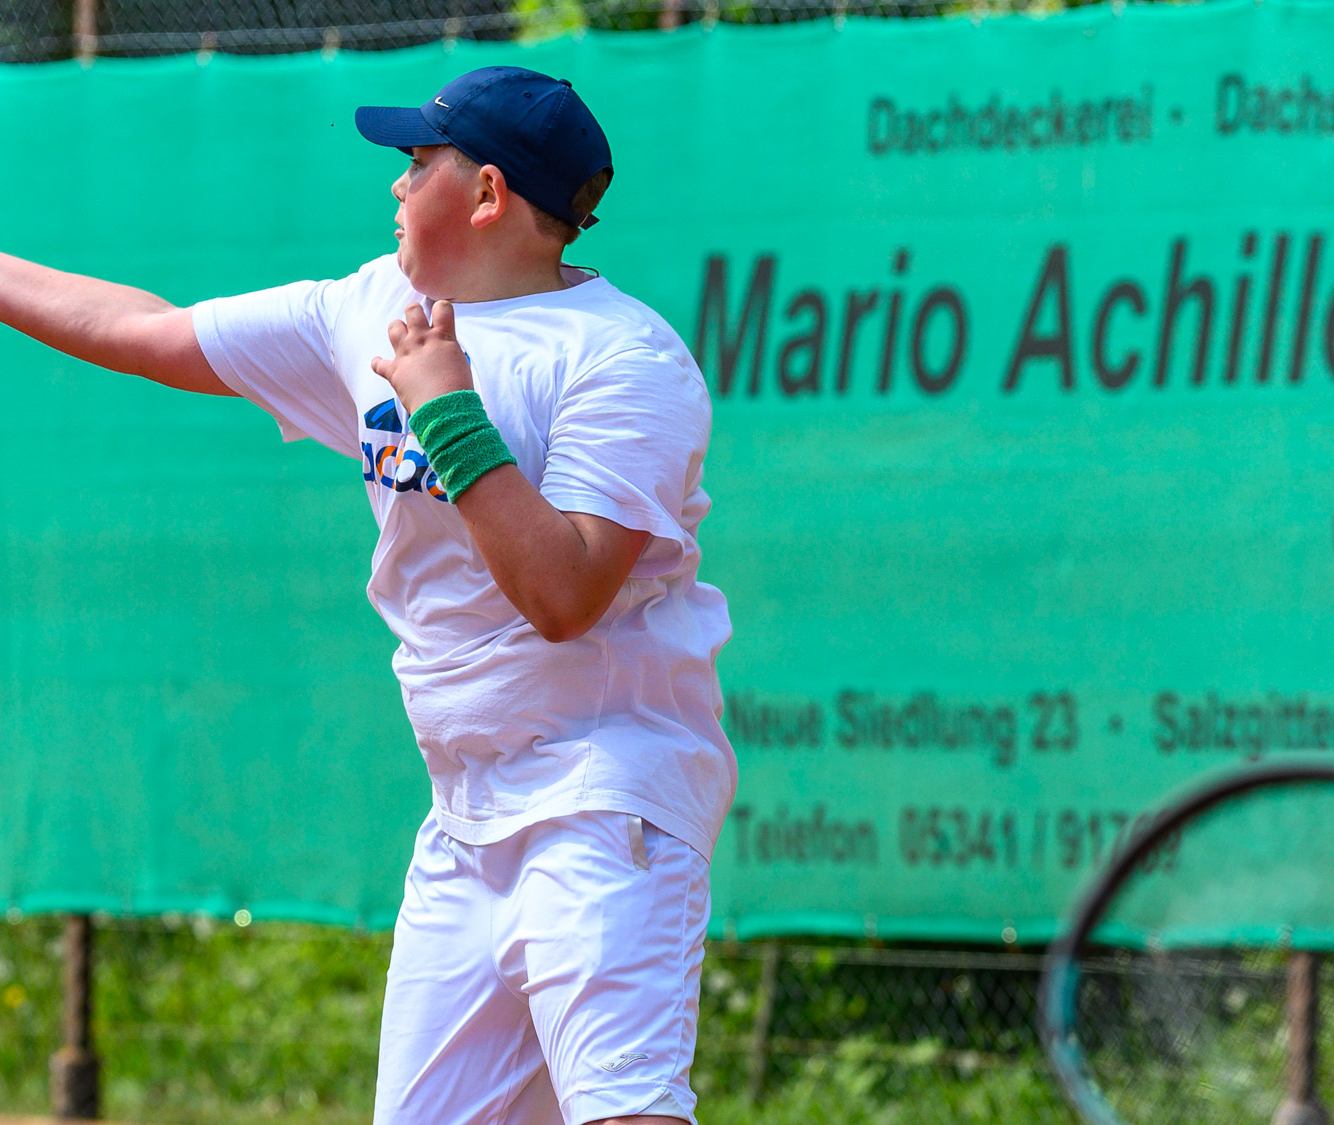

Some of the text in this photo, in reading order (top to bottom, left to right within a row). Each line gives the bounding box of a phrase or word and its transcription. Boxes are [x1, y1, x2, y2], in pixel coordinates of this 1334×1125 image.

[866, 86, 1154, 158] Dachdeckerei
[693, 247, 971, 399] Mario
[727, 692, 822, 750] Neue
[834, 687, 1017, 768] Siedlung
[1027, 689, 1081, 753] 23
[734, 804, 878, 867] Telefon
[901, 805, 1017, 868] 05341
